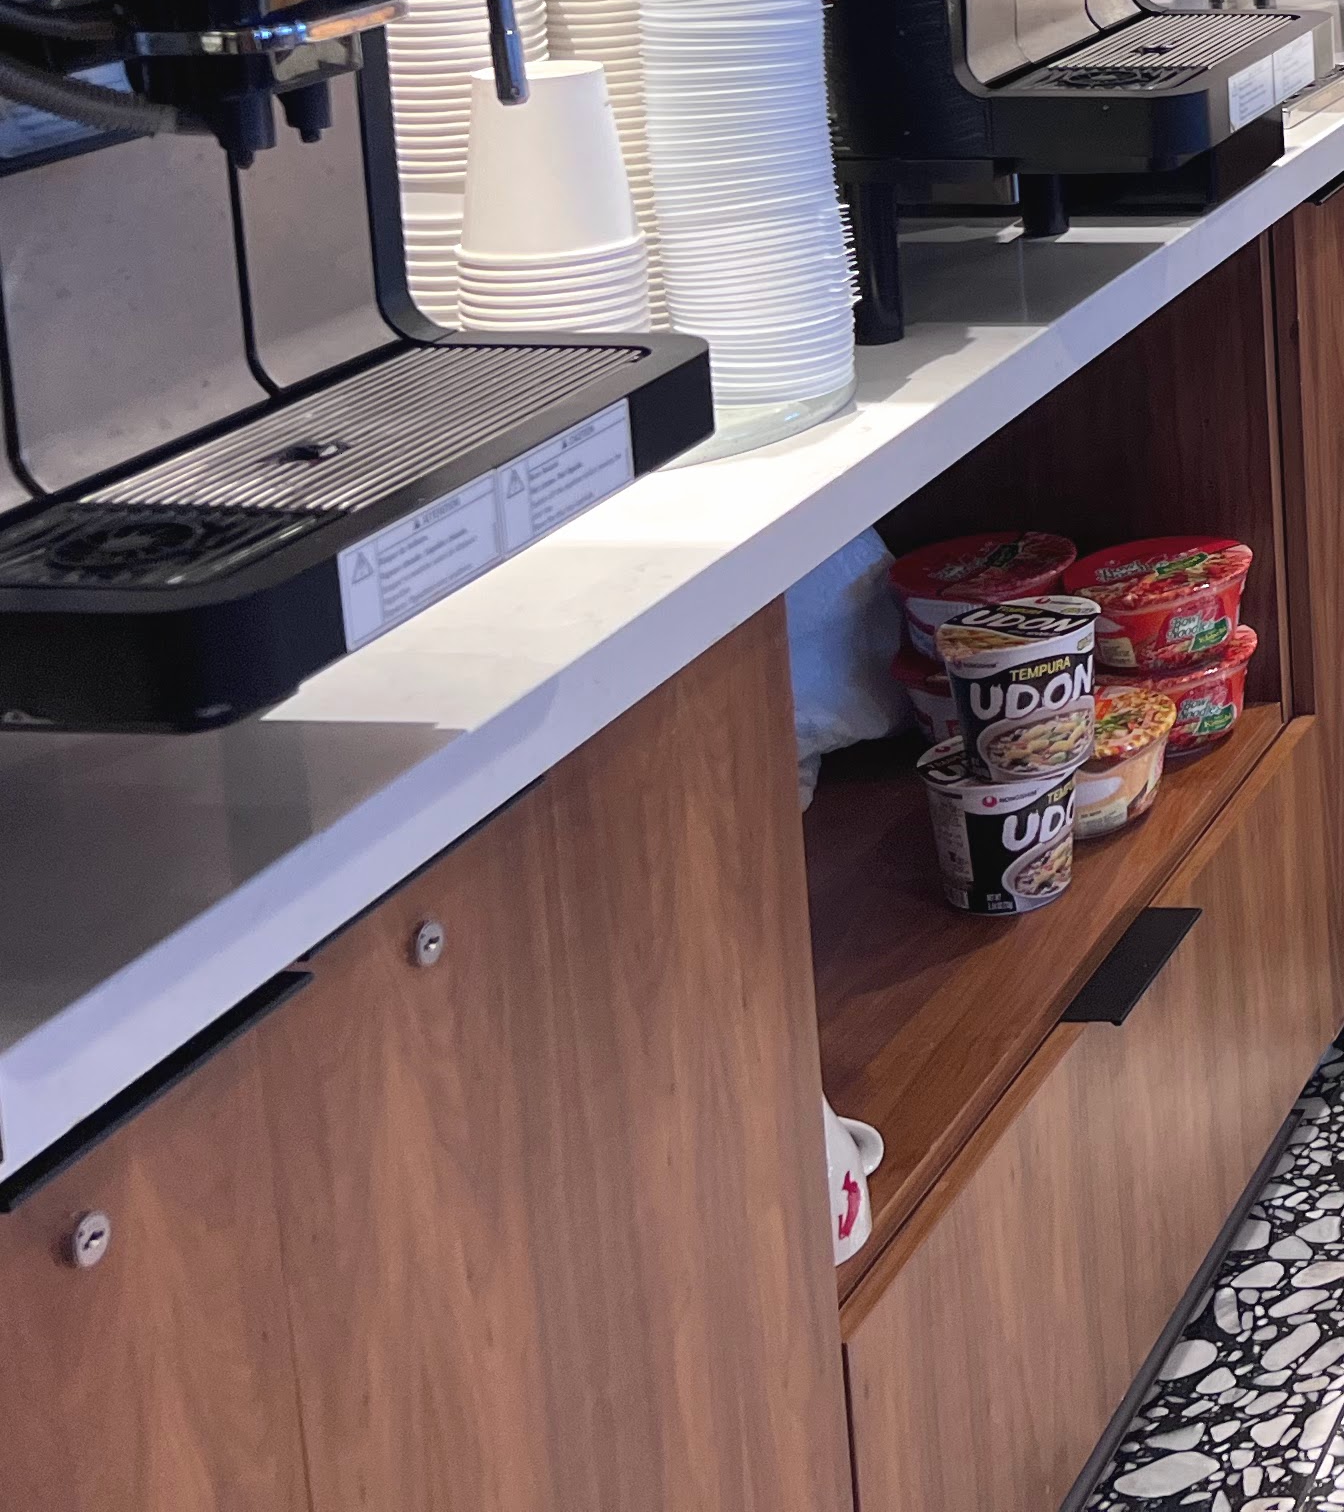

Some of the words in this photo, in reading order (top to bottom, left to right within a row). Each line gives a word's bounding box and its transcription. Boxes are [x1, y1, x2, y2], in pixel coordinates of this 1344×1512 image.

[961, 609, 1088, 632] UDON
[1009, 655, 1071, 682] TEMPURA
[969, 654, 1094, 721] UDON
